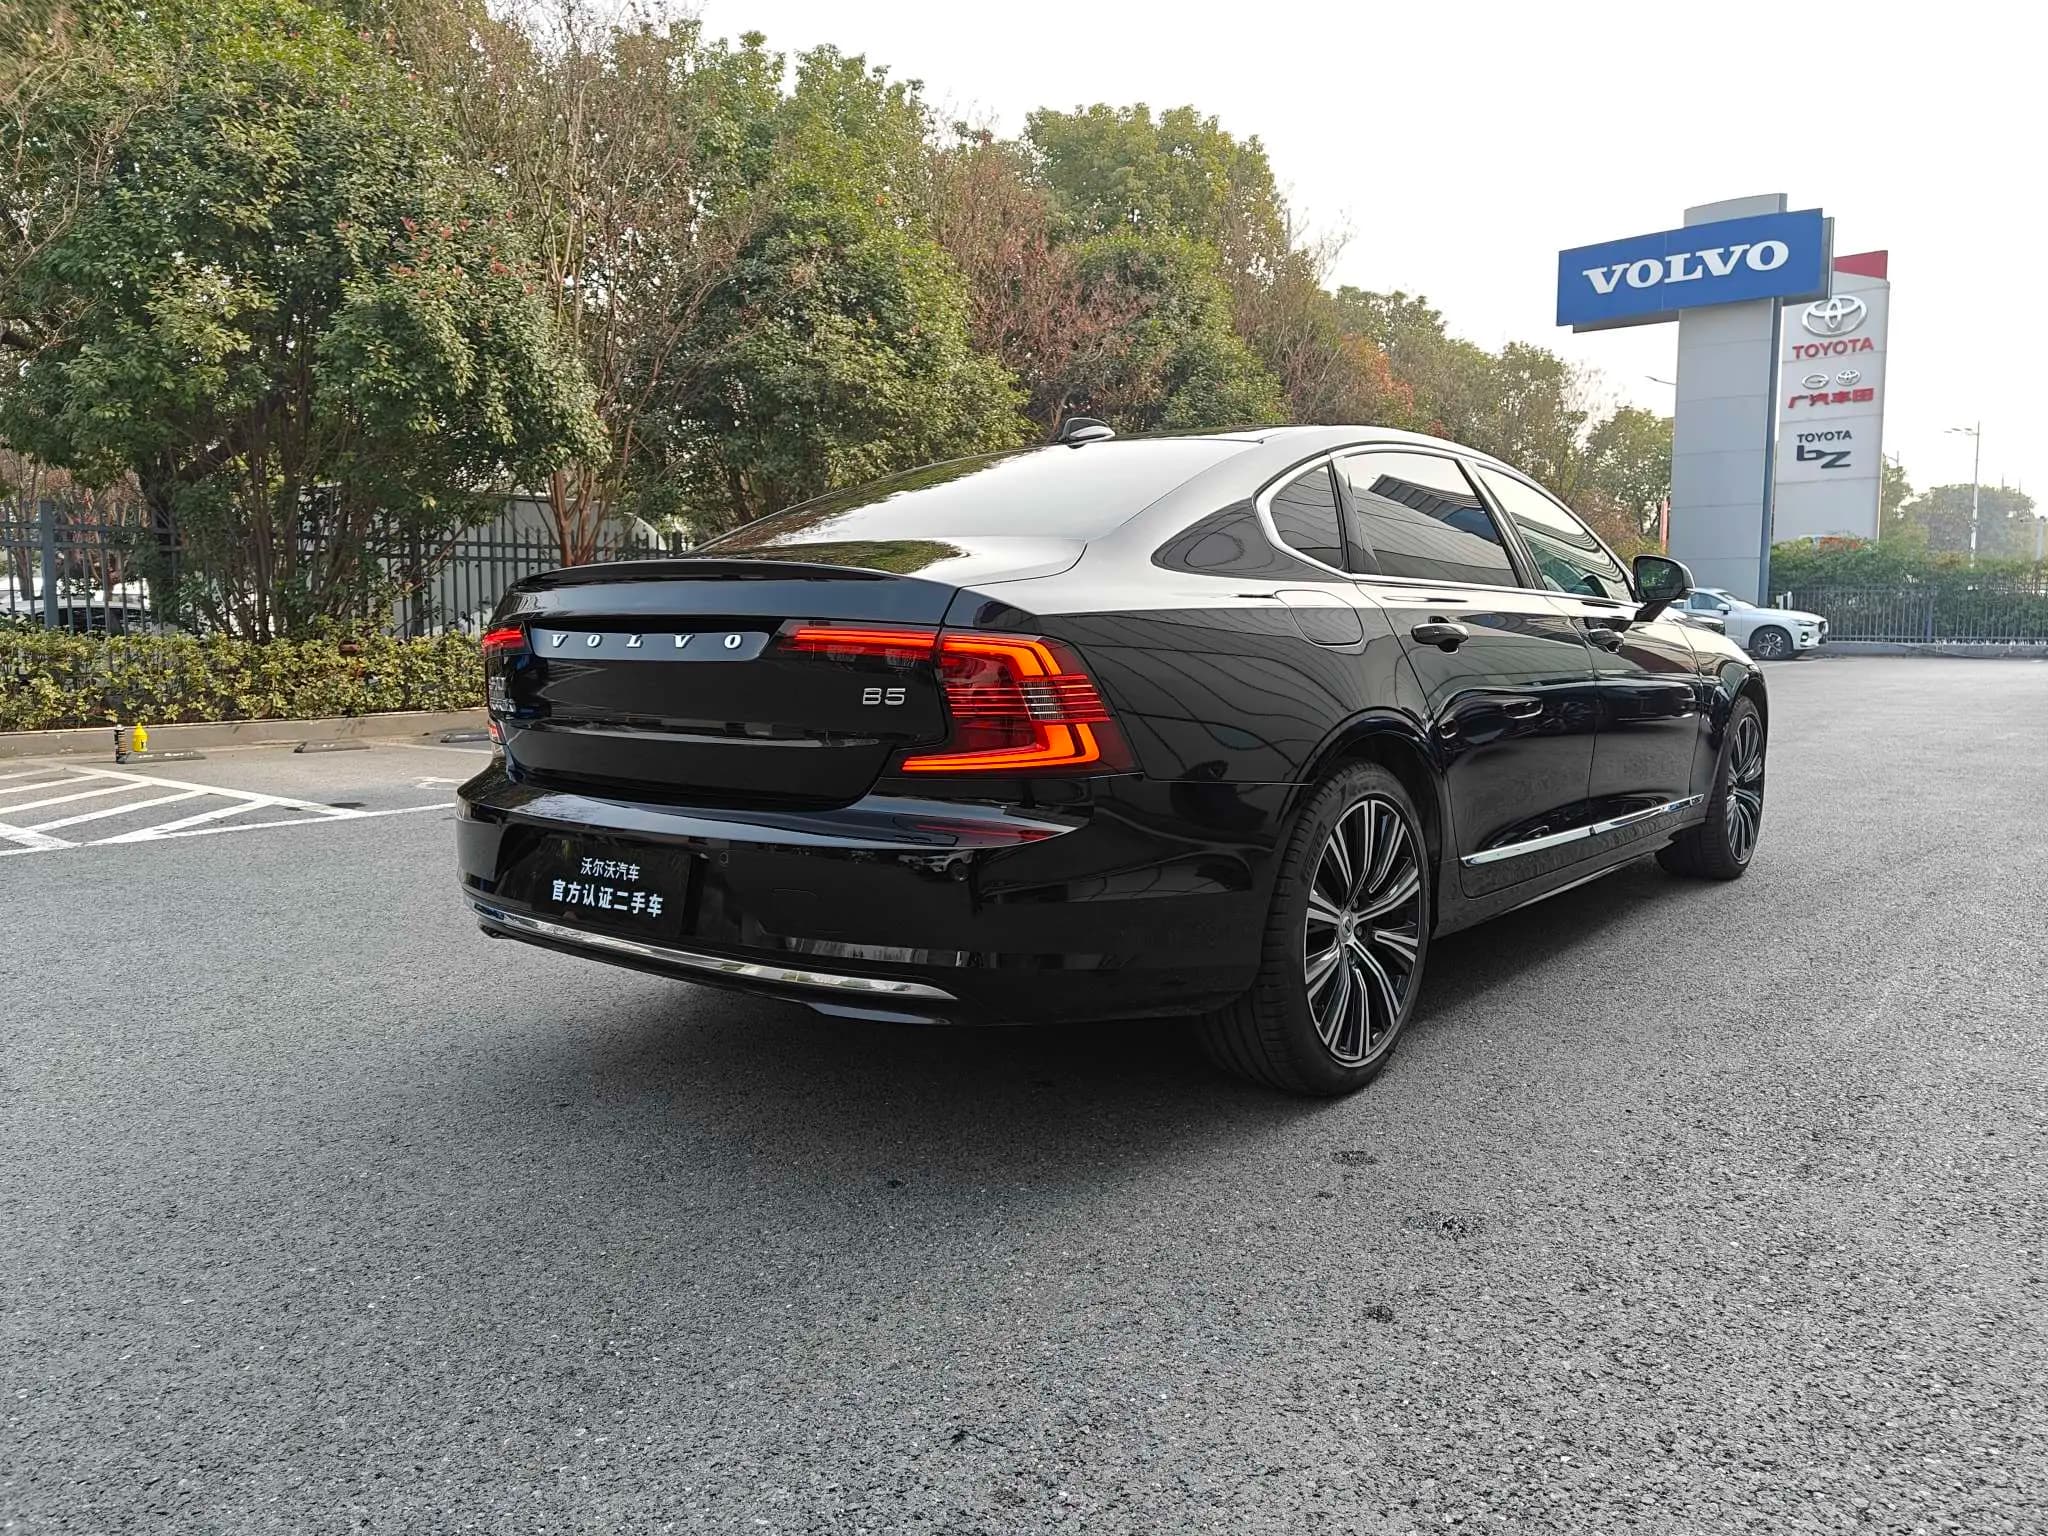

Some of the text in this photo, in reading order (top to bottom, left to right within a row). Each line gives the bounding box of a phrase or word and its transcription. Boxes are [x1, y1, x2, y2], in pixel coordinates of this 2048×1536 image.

[1582, 240, 1789, 295] VOLVO
[1792, 337, 1874, 359] TOYOTA
[1797, 430, 1852, 443] TOYOTA
[551, 634, 741, 649] VOLVO
[862, 687, 906, 706] B5
[580, 856, 640, 882] 沃尔沃汽车
[552, 879, 664, 918] 官方认证二手车
